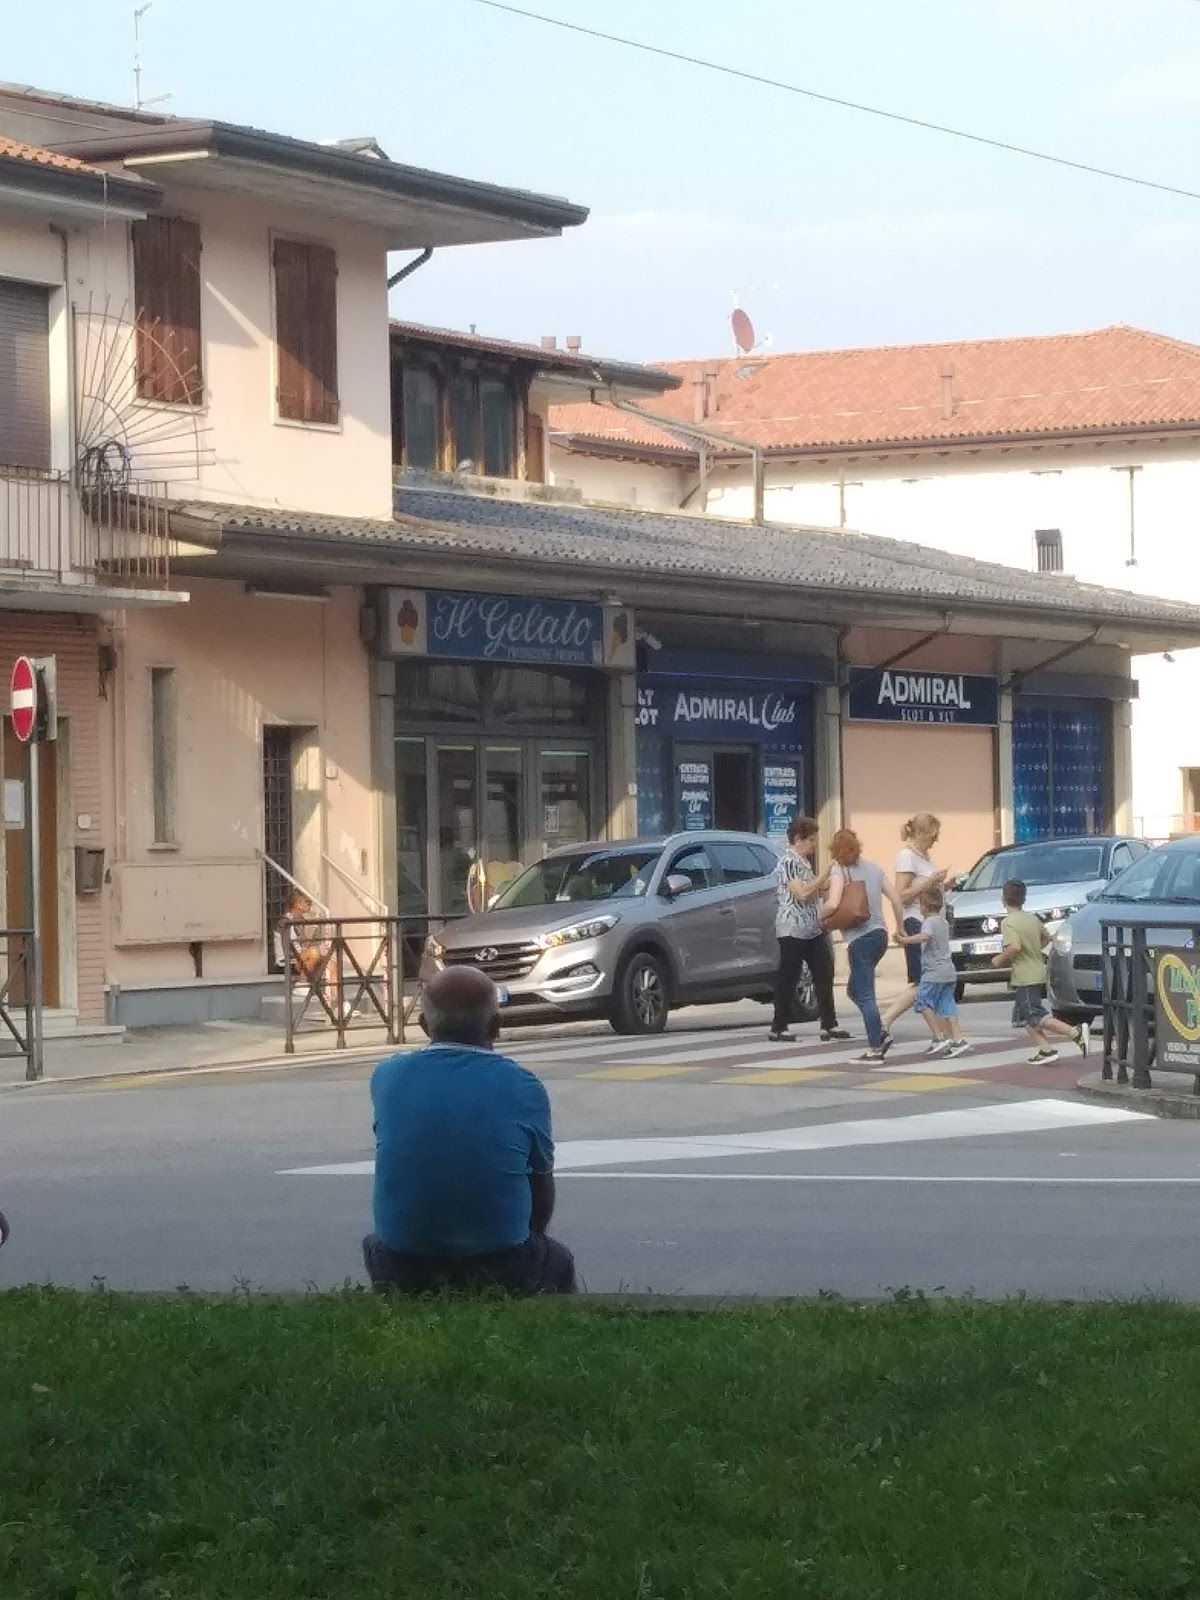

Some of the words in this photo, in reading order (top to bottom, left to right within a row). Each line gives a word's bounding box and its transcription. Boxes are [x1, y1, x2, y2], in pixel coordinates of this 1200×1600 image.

[434, 596, 475, 640] Il
[478, 597, 593, 656] Gelato
[637, 688, 655, 706] LT
[878, 671, 971, 709] ADMIRAL
[674, 692, 760, 725] ADMIRAL
[761, 693, 796, 730] Club
